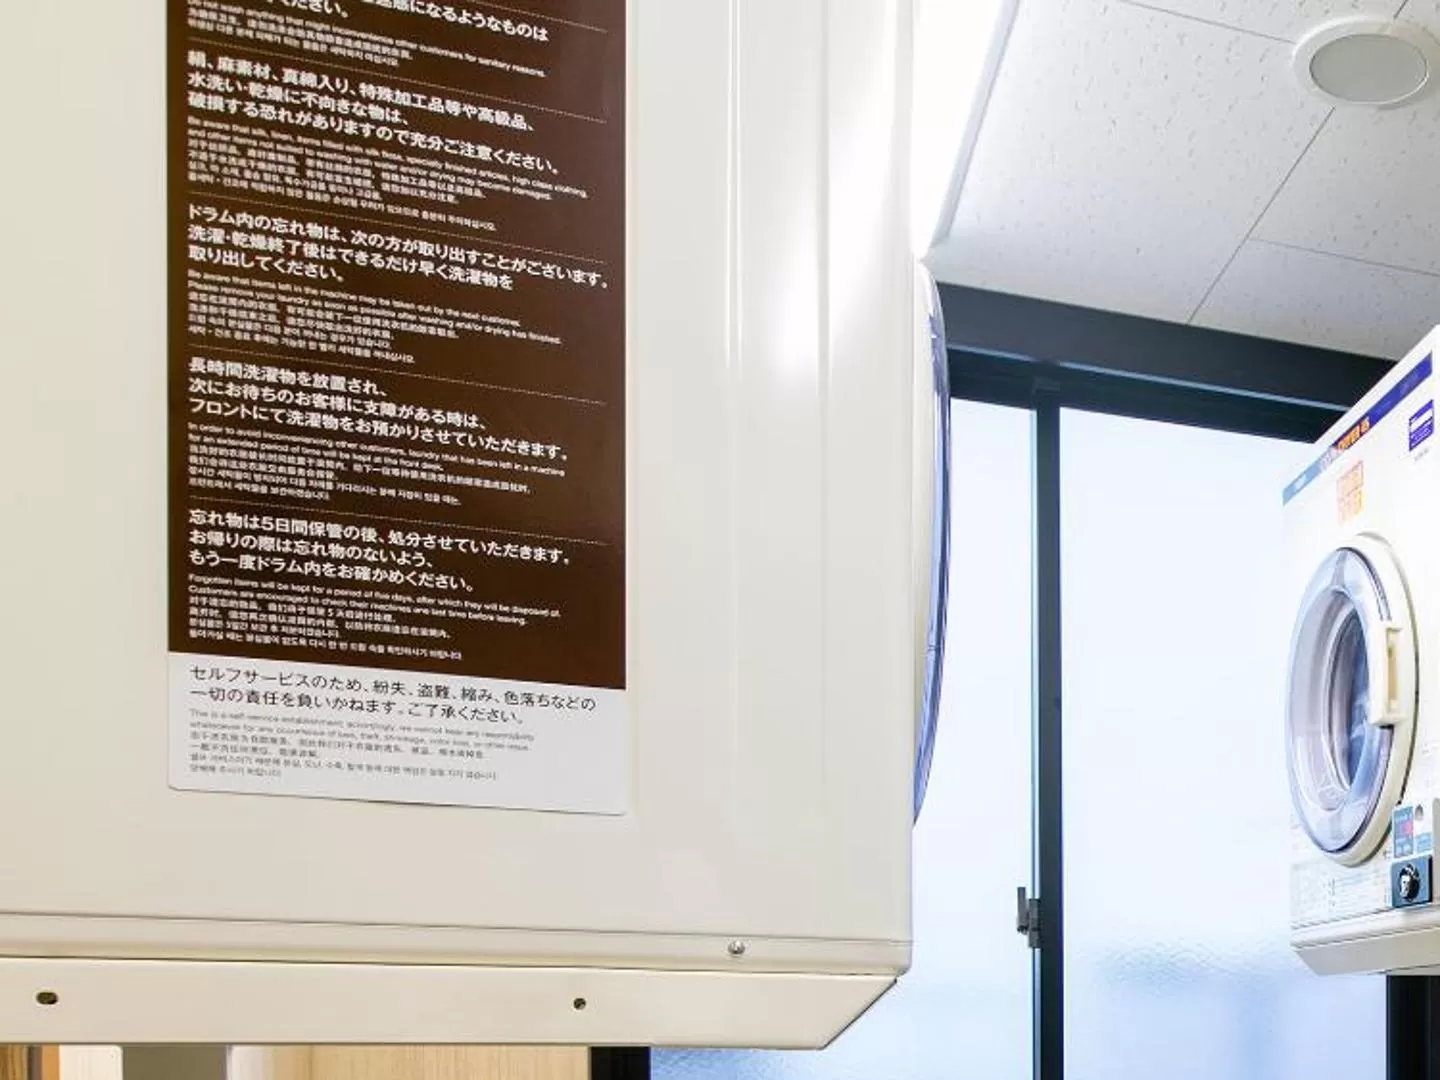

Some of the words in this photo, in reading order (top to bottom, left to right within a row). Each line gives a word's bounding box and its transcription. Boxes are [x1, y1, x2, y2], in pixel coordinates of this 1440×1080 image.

[190, 685, 523, 724] 一切の責任を負いかねます。ご了承ください。
